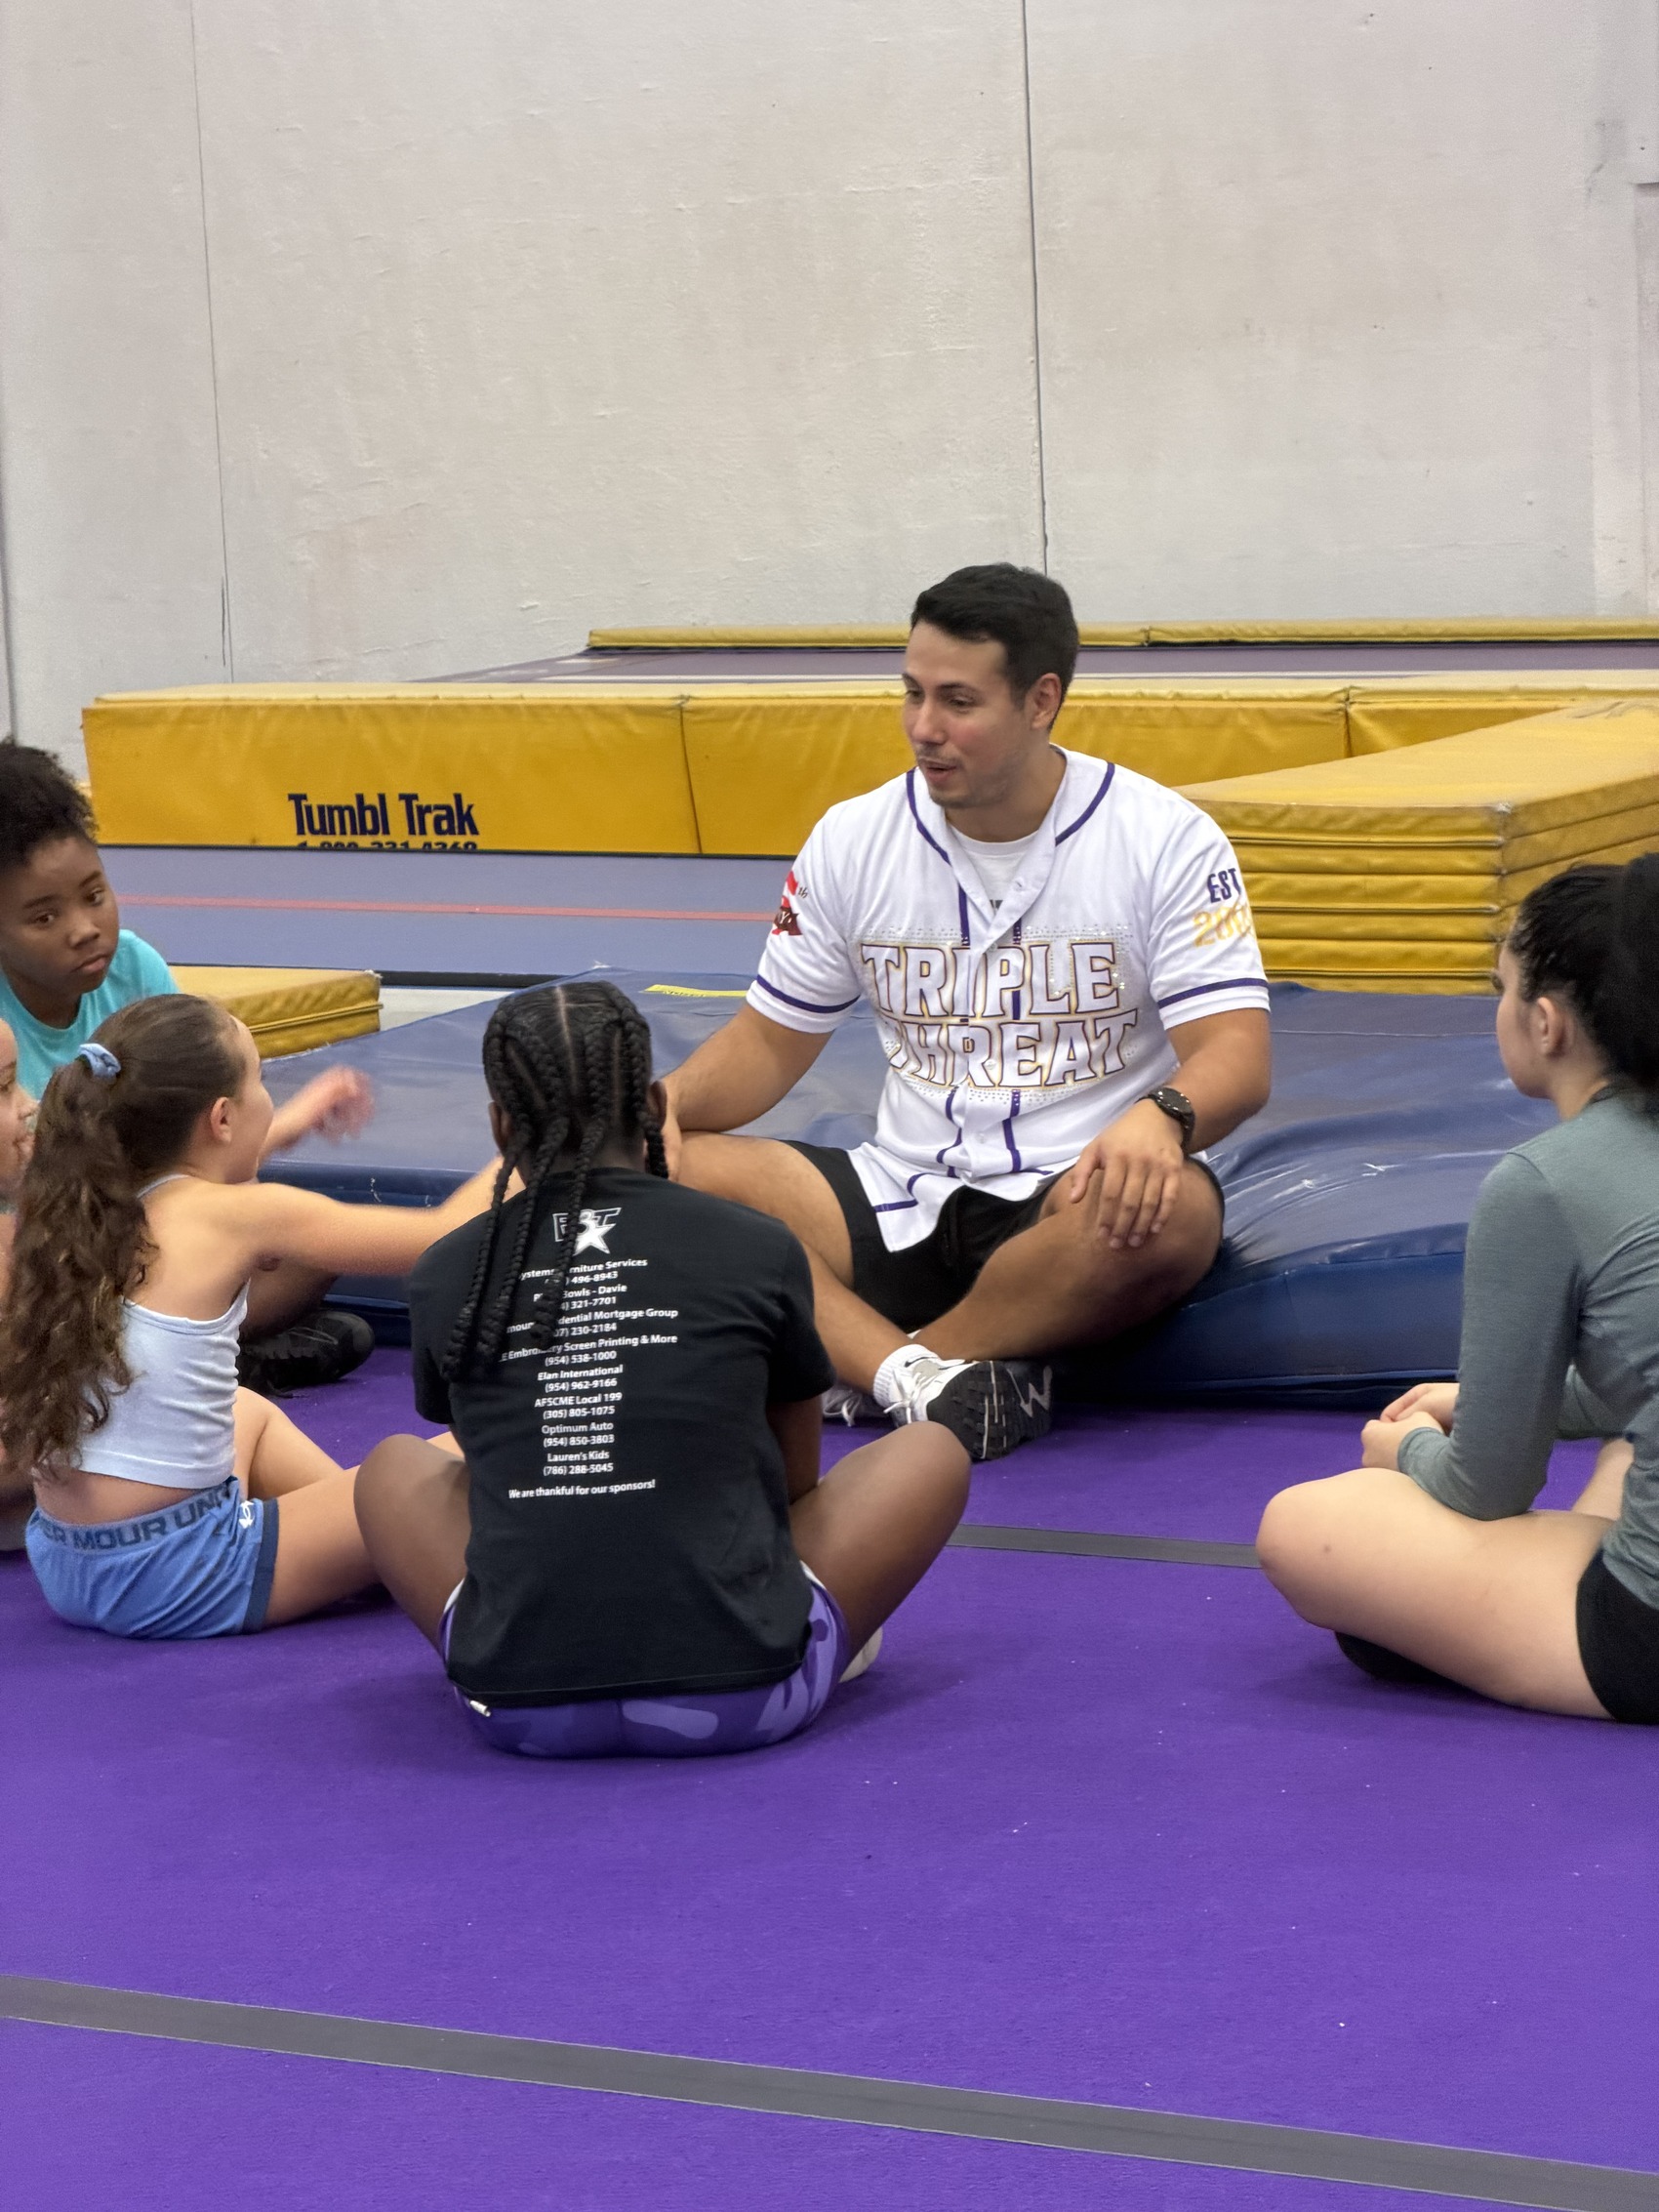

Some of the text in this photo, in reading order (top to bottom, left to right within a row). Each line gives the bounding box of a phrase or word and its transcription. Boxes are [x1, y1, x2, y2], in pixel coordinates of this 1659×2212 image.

[288, 793, 479, 836] Tumbl Trak
[1207, 868, 1241, 903] EST
[860, 941, 1120, 1018] TRIPLE
[519, 1269, 555, 1281] ystem
[605, 1259, 648, 1269] Services
[571, 1271, 619, 1284] 496-8943
[598, 1284, 627, 1294] Davie
[571, 1296, 617, 1309] 321-7701
[594, 1310, 645, 1320] Mortgage
[646, 1308, 678, 1319] Group
[571, 1323, 617, 1335] 230-2184
[564, 1341, 596, 1352] Screen
[598, 1336, 639, 1346] Printing
[640, 1334, 649, 1344] &
[651, 1334, 678, 1343] More
[546, 1350, 617, 1367] (954) 538-1000
[538, 1364, 624, 1380] Elan International
[546, 1378, 618, 1393] (954) 962-9166
[535, 1392, 623, 1408] AFSCME Local 199
[544, 1406, 615, 1420] (305) 805-1075
[542, 1422, 614, 1435] Optimum Auto
[544, 1434, 615, 1448] (954) 850-3803
[547, 1450, 610, 1462] Lauren's Kids
[544, 1462, 614, 1476] (786) 288-5045
[508, 1490, 520, 1498] We
[535, 1486, 574, 1496] thankful
[575, 1486, 589, 1495] for
[609, 1479, 656, 1494] sponsors!
